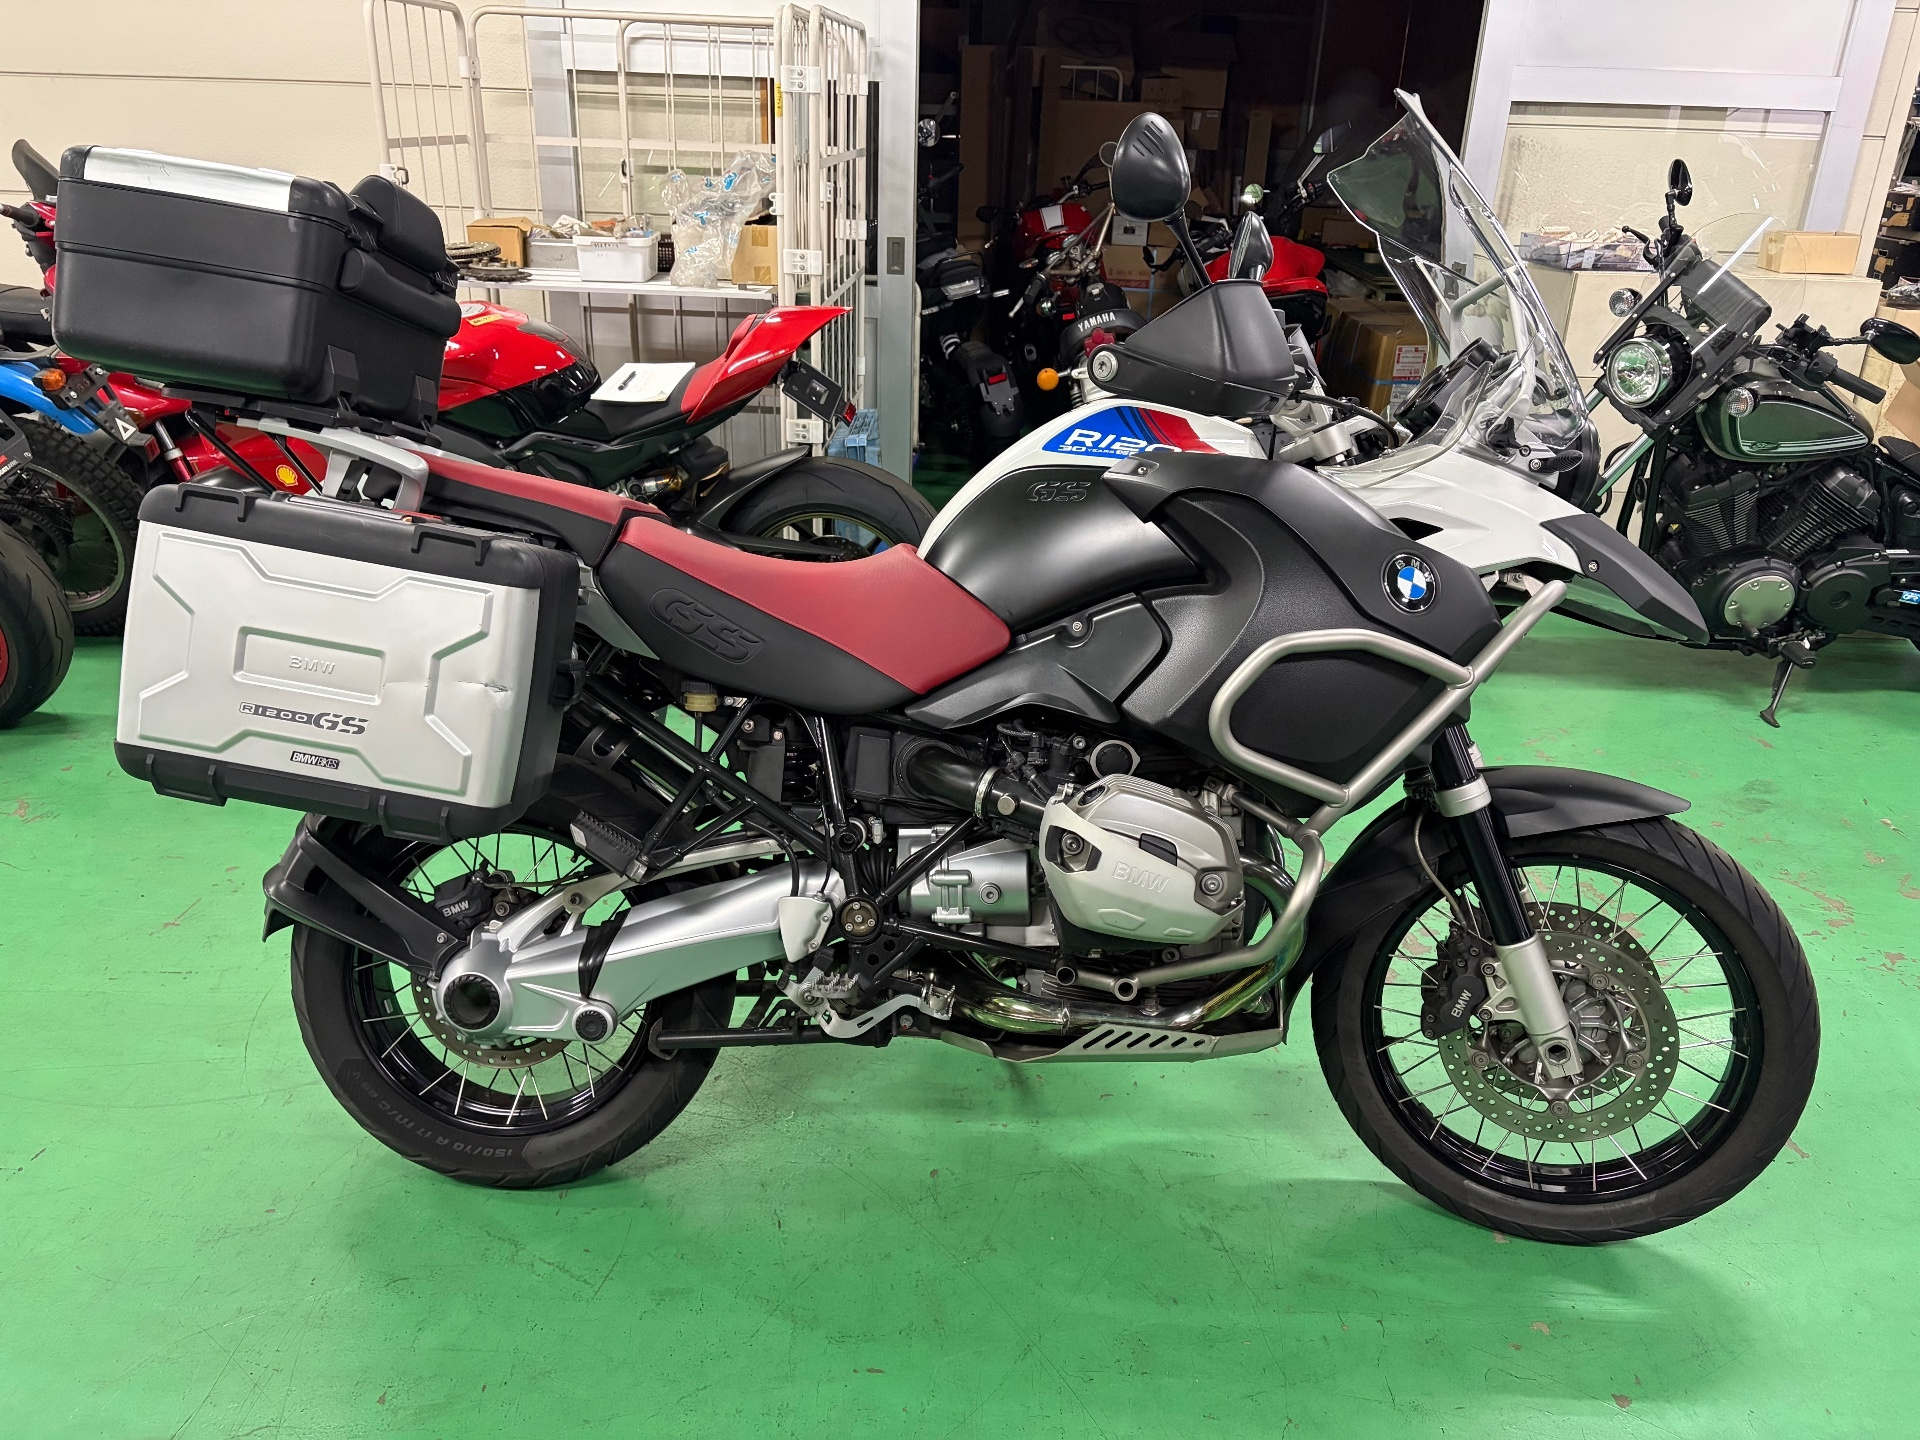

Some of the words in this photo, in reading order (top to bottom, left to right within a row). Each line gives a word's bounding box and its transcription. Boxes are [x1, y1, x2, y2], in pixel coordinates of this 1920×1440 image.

[1077, 311, 1116, 332] YAMAHA
[1058, 444, 1086, 452] 30
[1025, 481, 1092, 502] GS
[1395, 559, 1433, 582] BMW
[652, 588, 762, 662] GS
[289, 655, 336, 675] BMW
[1113, 861, 1170, 893] BMW
[442, 899, 469, 918] BMW
[1450, 989, 1472, 1018] BMW
[434, 1135, 450, 1146] R
[452, 1141, 513, 1157] 150/70
